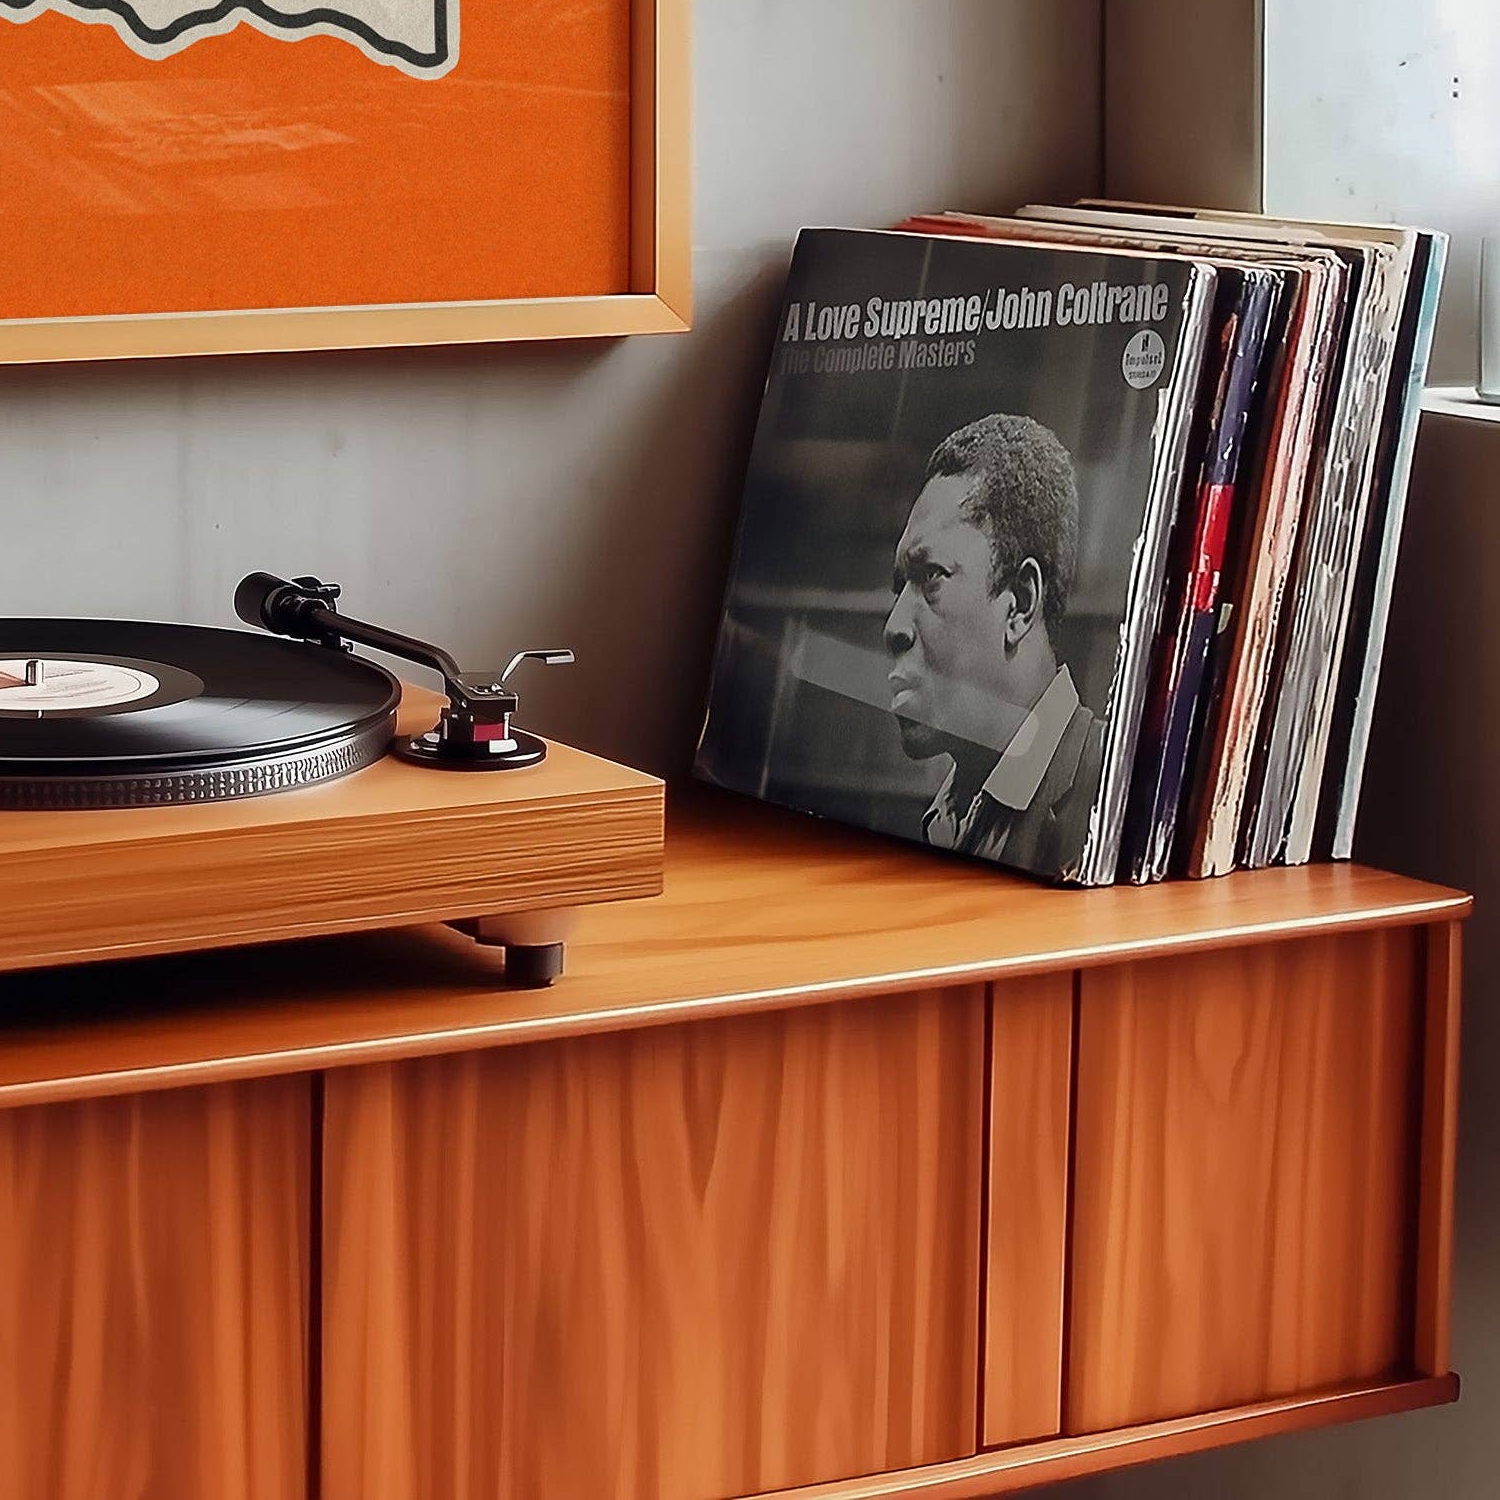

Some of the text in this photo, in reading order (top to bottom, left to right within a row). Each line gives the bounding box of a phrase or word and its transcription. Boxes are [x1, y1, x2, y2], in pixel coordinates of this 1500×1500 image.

[783, 303, 800, 341] A
[805, 302, 861, 341] Love
[1057, 281, 1168, 325] Coltrane
[780, 339, 976, 376] The Complete Masters
